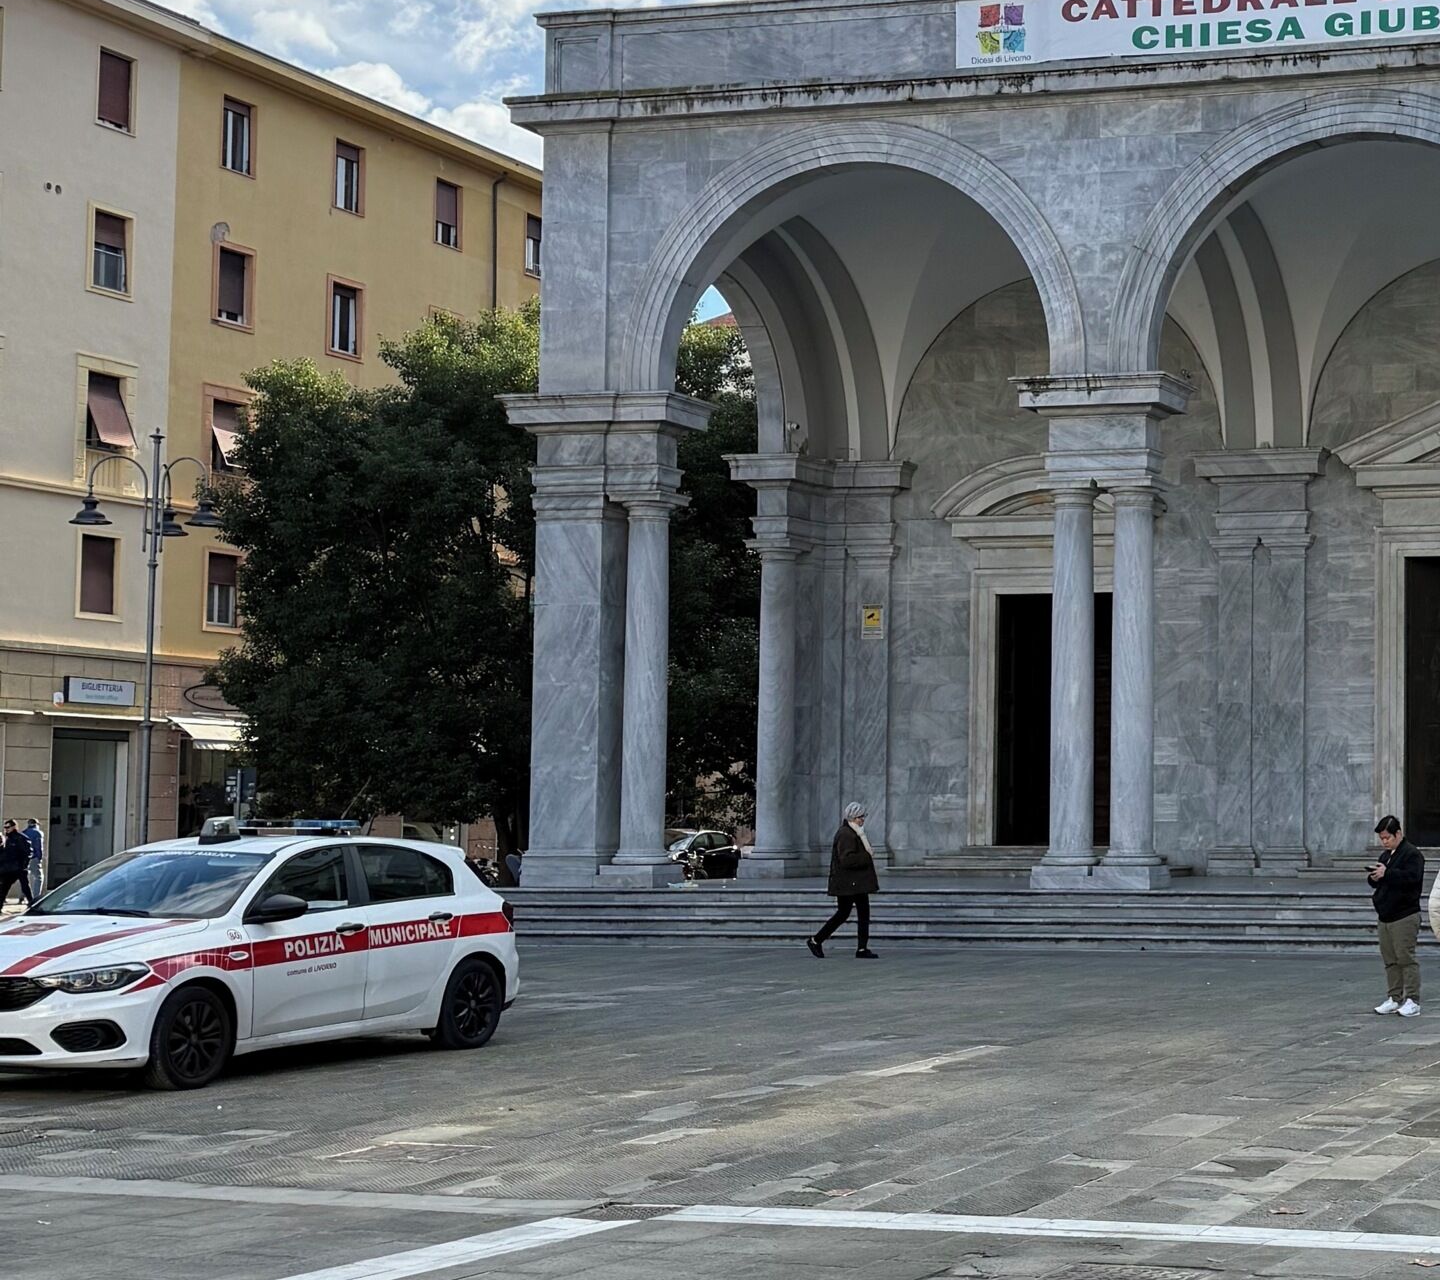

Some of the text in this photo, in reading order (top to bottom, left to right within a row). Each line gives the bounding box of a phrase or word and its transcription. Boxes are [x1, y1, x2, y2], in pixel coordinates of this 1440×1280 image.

[1131, 16, 1305, 50] CHIESA
[995, 55, 1003, 63] di
[81, 682, 123, 693] BIGLIETTERIA
[283, 921, 452, 959] POLIZIA MUNICIPALE
[314, 961, 337, 972] LIVORNO
